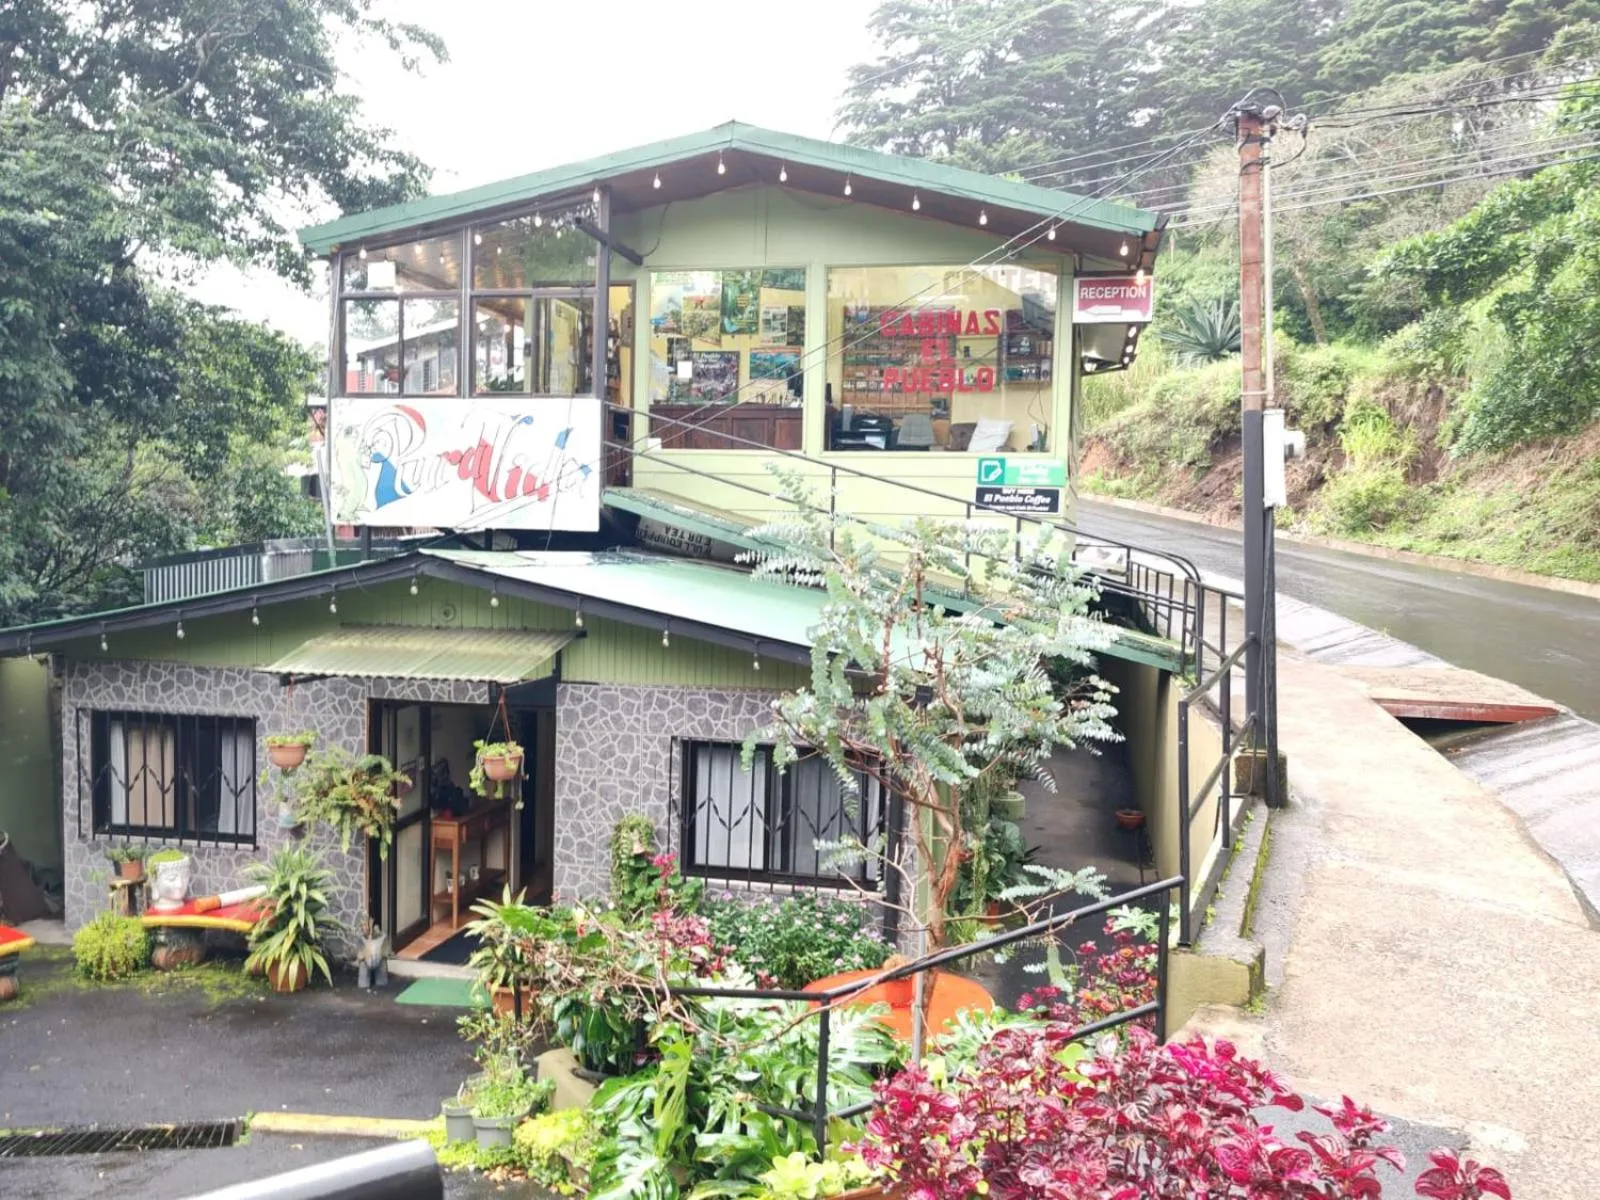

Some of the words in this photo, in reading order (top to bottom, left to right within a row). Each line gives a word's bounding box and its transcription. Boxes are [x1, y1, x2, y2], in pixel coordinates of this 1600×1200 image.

[1081, 286, 1147, 299] RECEPTION
[881, 309, 1000, 336] CABINAS
[921, 337, 956, 366] EL
[883, 367, 994, 392] PUEBLO
[1024, 495, 1051, 506] Coffee
